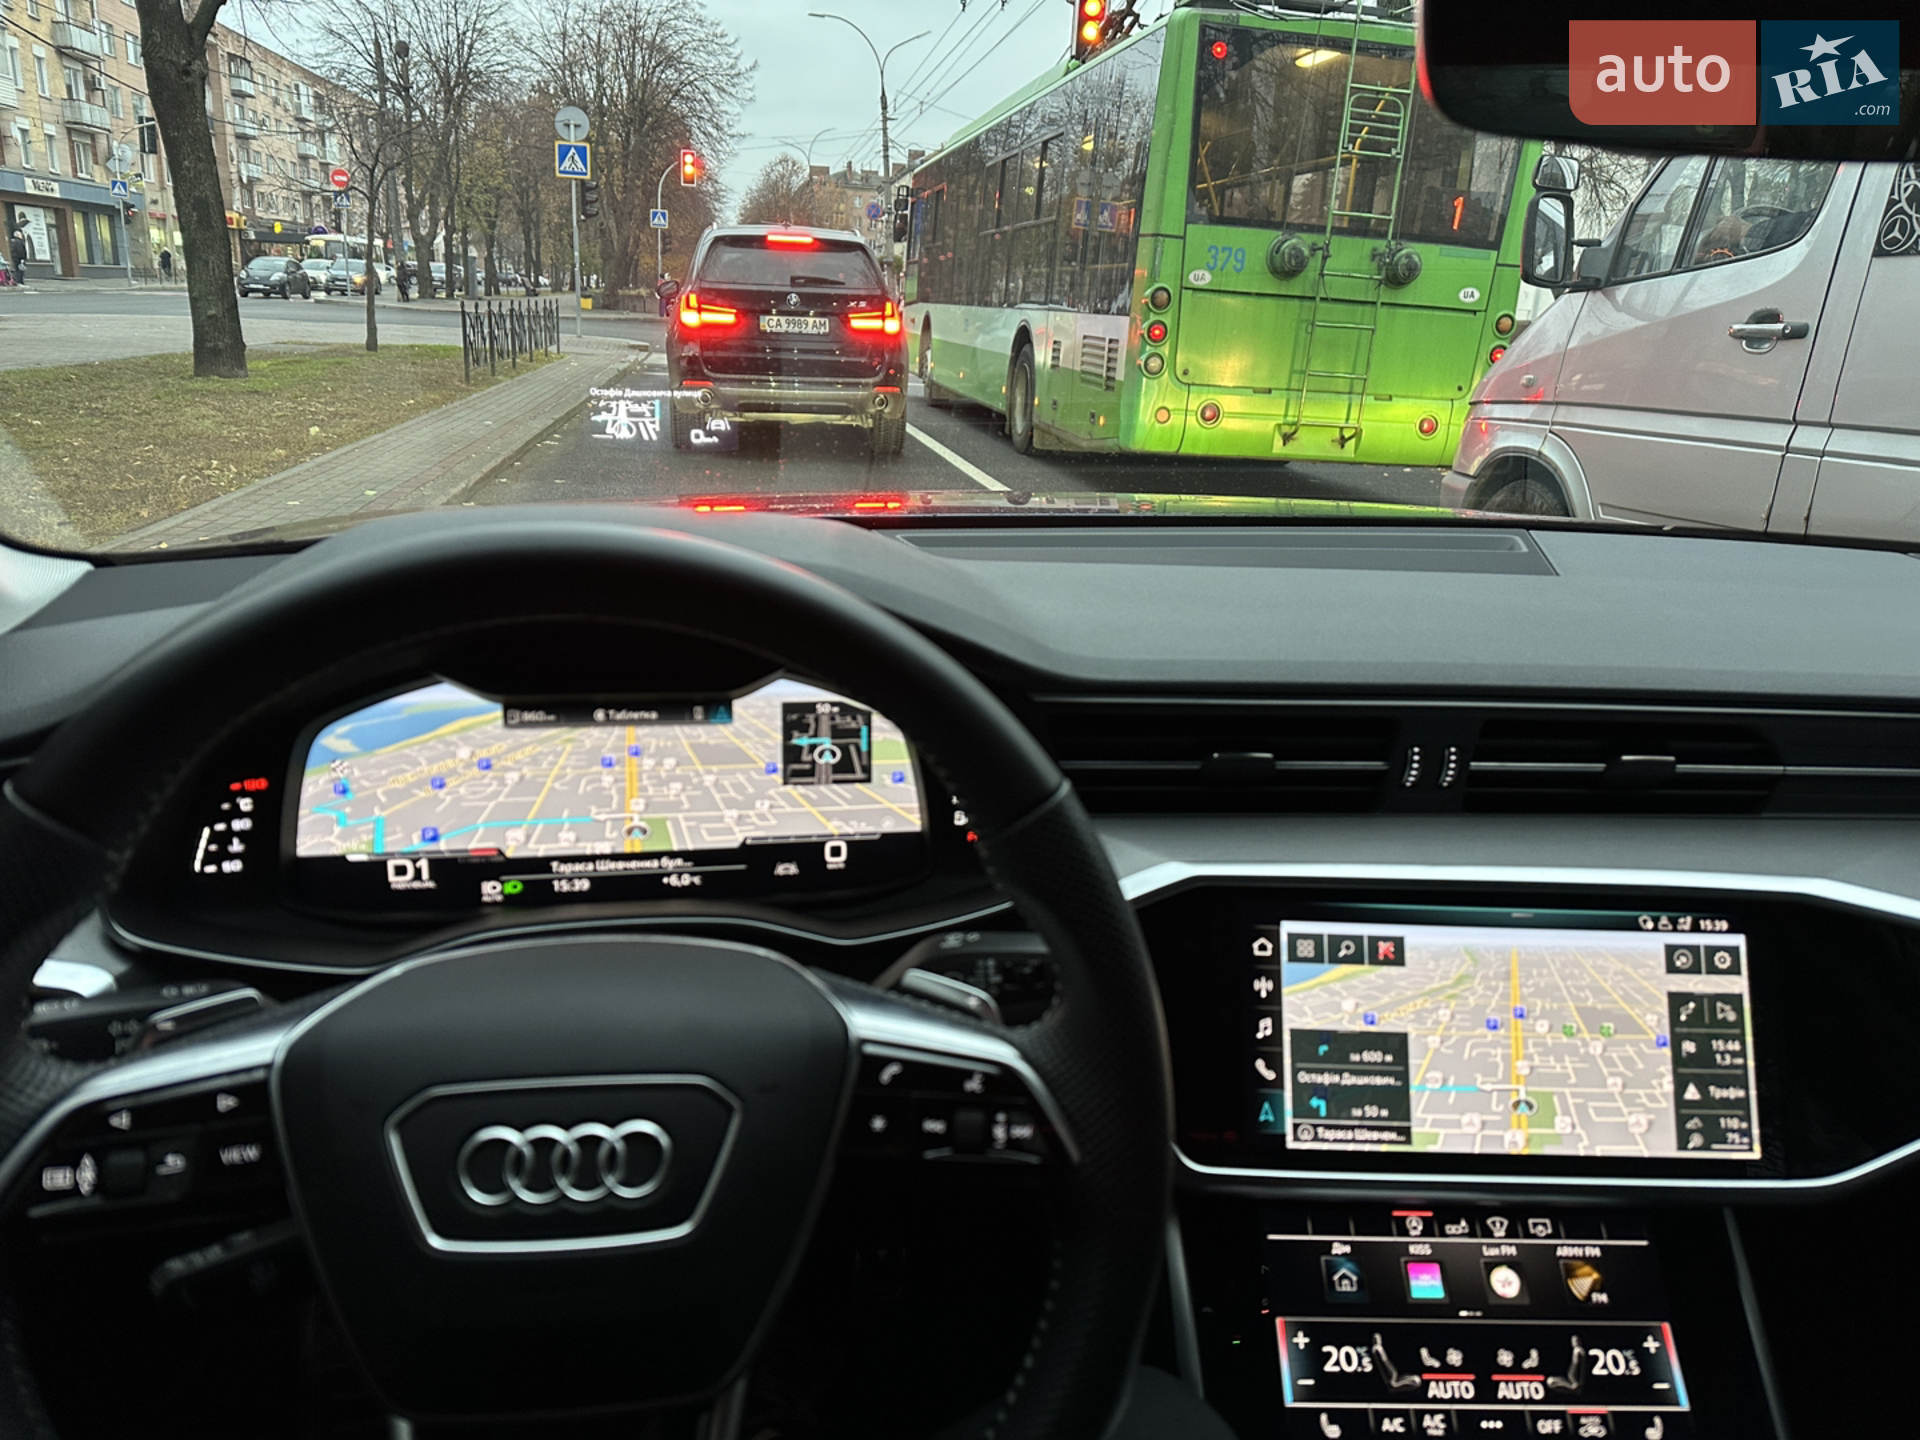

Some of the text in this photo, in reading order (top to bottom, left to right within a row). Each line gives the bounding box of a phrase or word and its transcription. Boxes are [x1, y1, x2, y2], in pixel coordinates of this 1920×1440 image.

[1452, 195, 1465, 231] 1
[1205, 244, 1246, 273] 379
[1192, 272, 1207, 283] UA
[1462, 289, 1476, 300] UA
[766, 317, 828, 331] CA 9989 AM
[608, 708, 659, 721] Таблетка
[386, 857, 431, 883] D1
[550, 860, 594, 875] Тараса
[595, 858, 660, 872] Шевченка
[552, 877, 591, 893] 15:39
[1698, 918, 1730, 932] 15:39
[1361, 1049, 1384, 1063] 600
[1315, 1126, 1354, 1142] Тараса
[219, 1143, 261, 1166] VIEW
[1500, 1244, 1518, 1257] FM
[1584, 1246, 1602, 1258] FM
[1427, 1380, 1476, 1400] AUTO
[1497, 1381, 1546, 1401] AUTO
[1536, 1418, 1563, 1435] OFF
